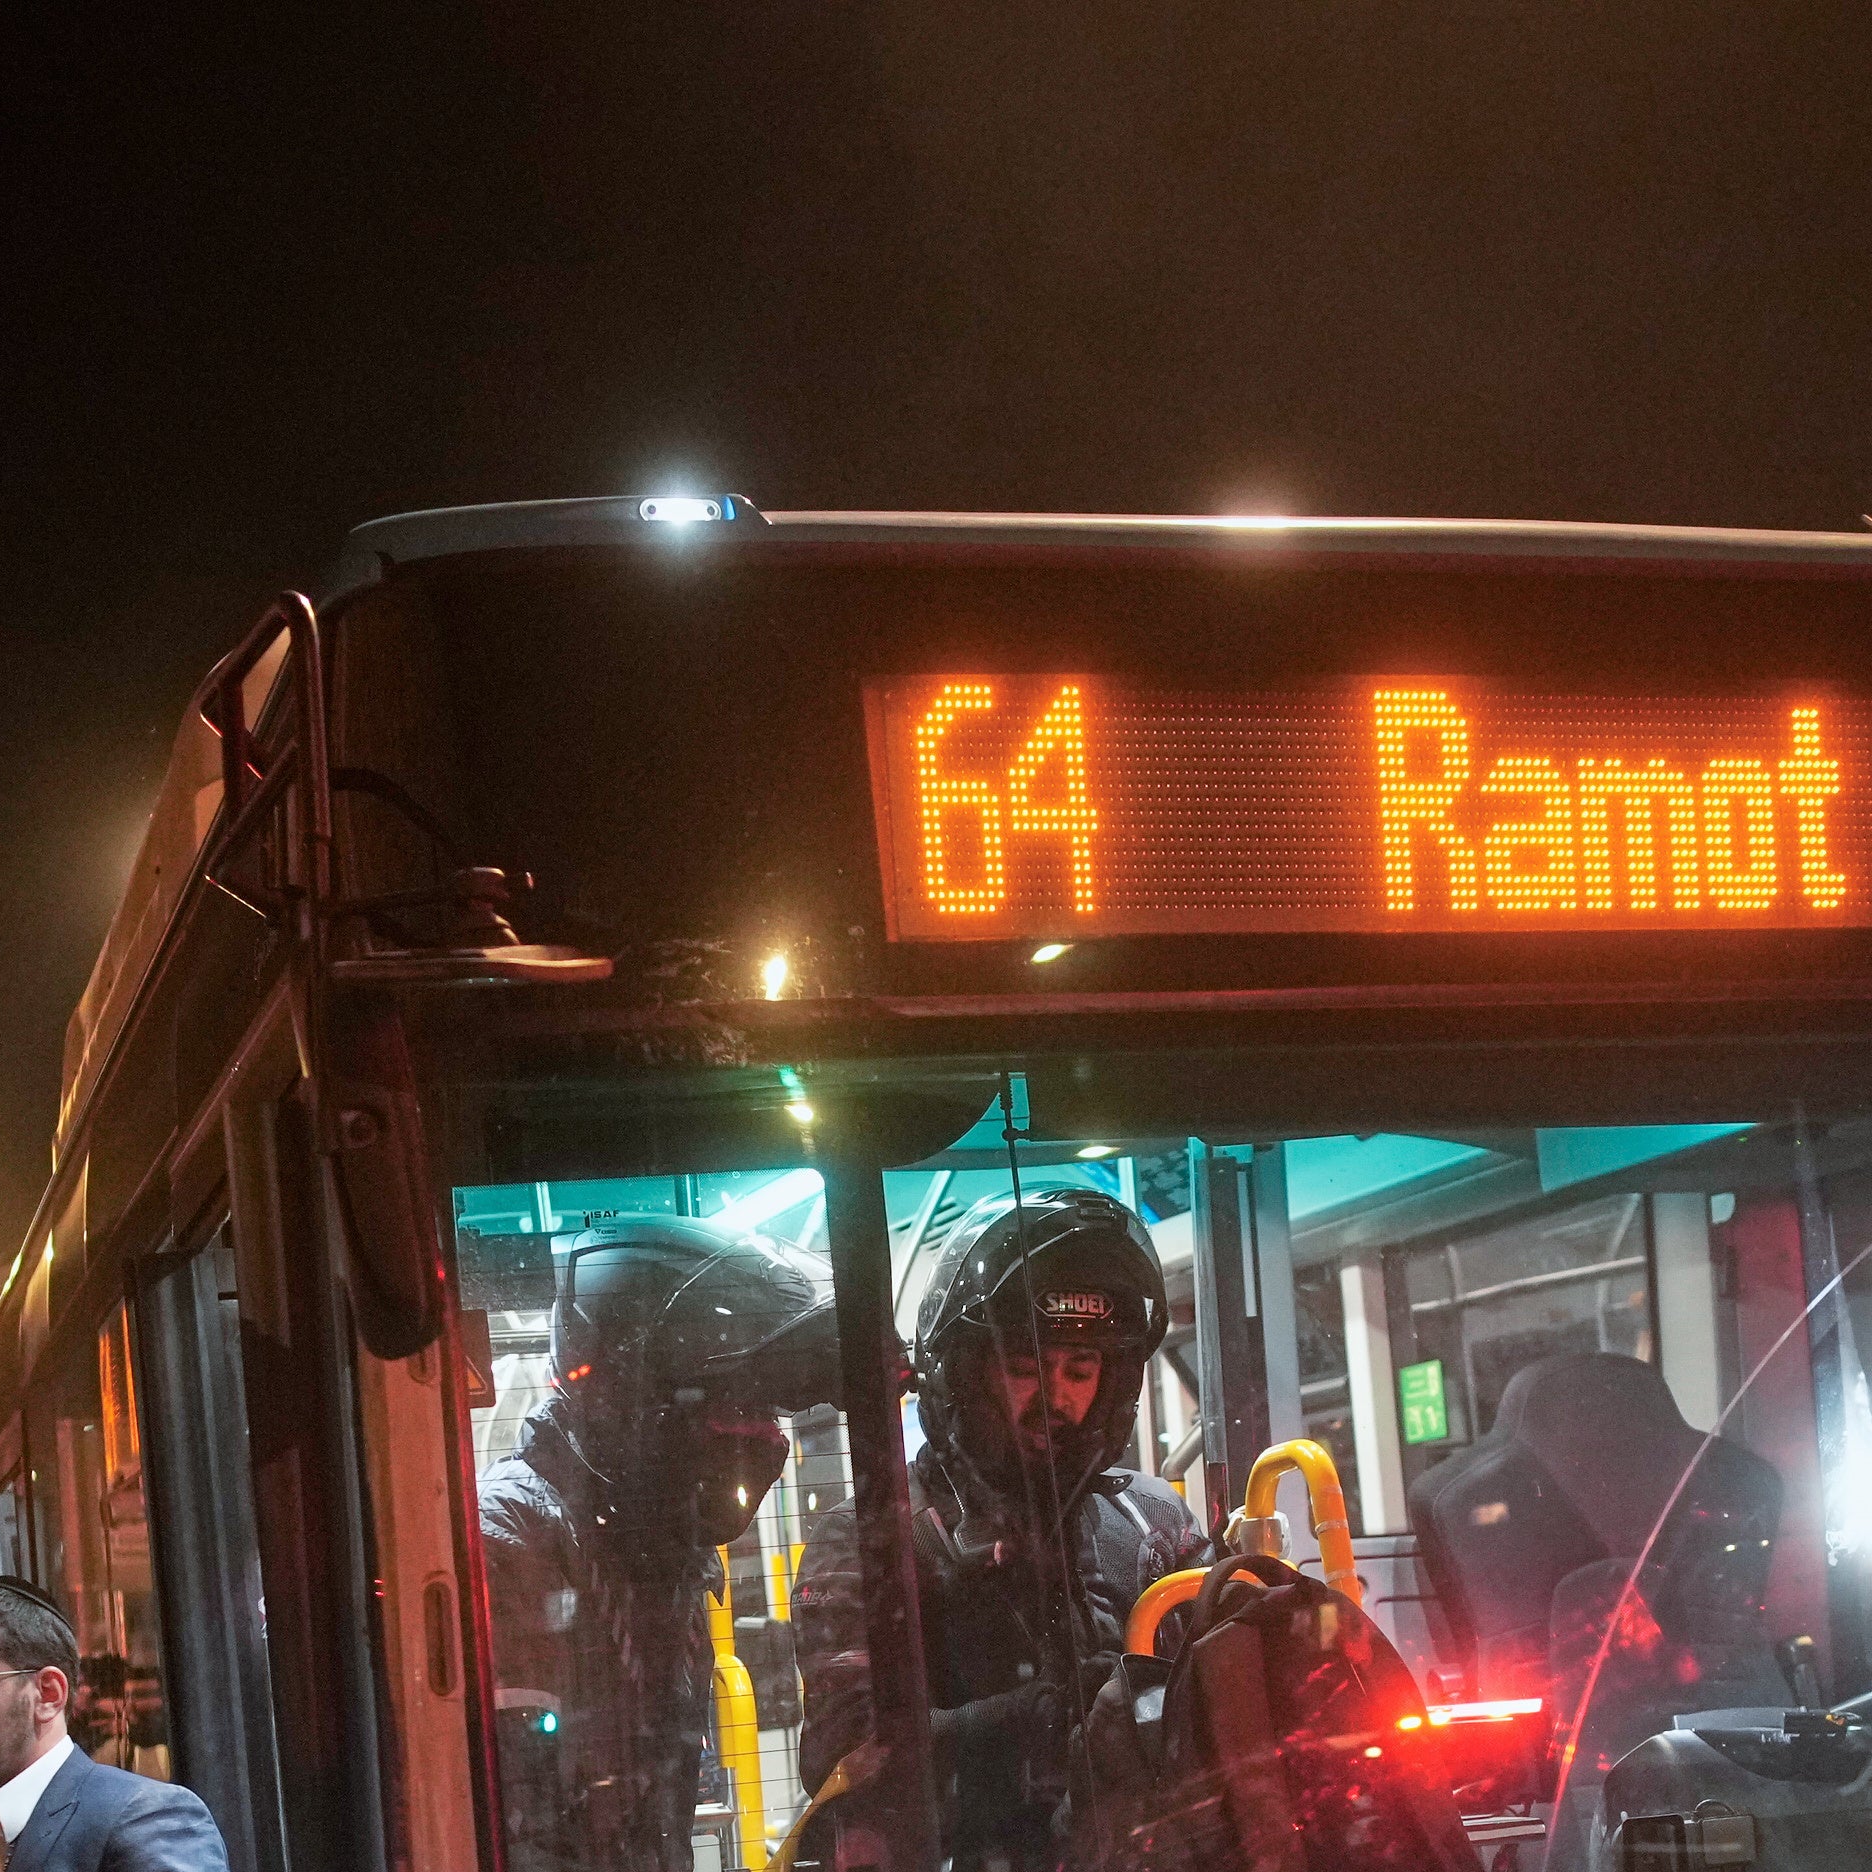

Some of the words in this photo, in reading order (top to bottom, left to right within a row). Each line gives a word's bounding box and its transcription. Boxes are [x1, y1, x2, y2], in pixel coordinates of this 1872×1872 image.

[915, 683, 1099, 913] 64
[1373, 689, 1848, 910] Ramot
[1046, 1292, 1105, 1314] SHOEI
